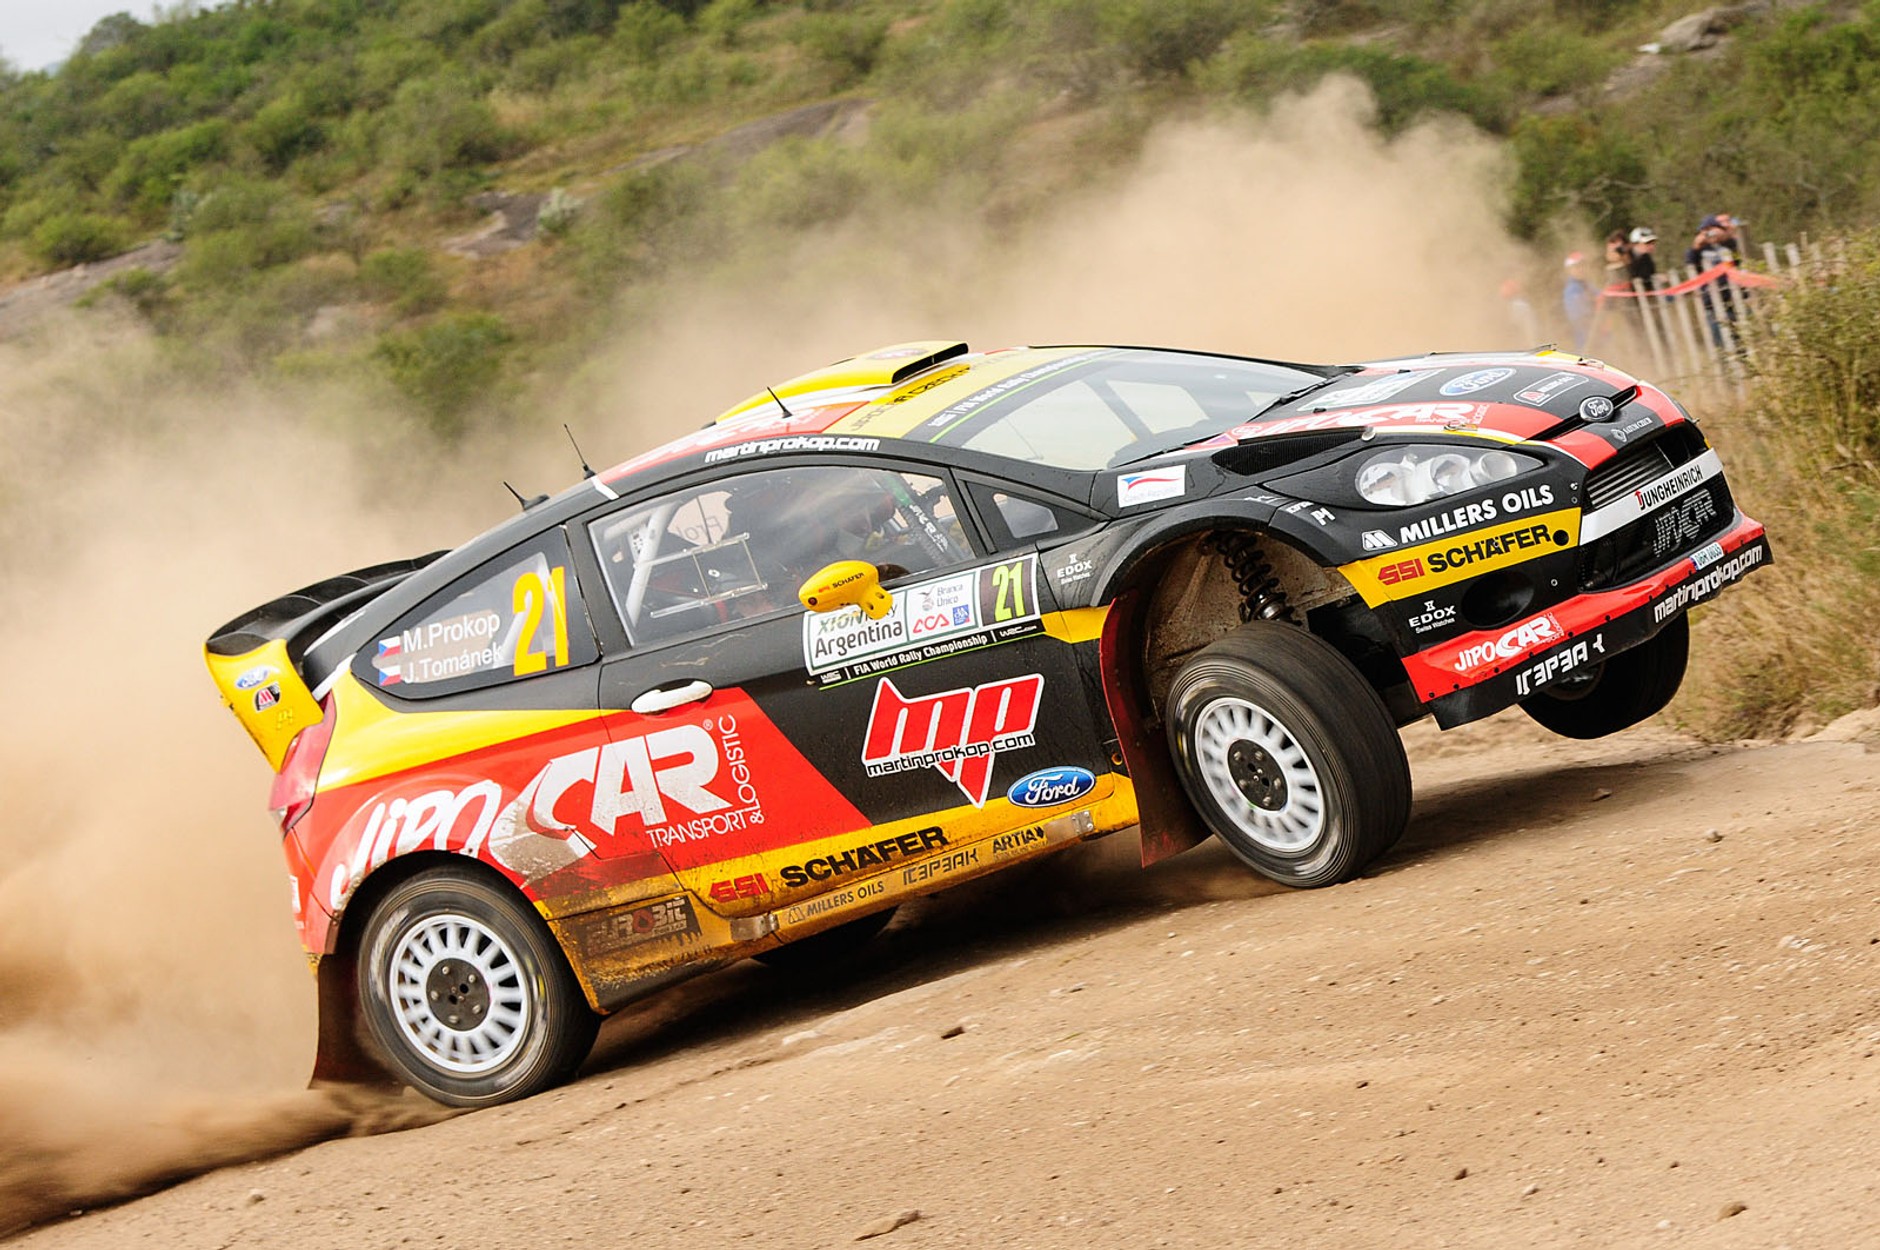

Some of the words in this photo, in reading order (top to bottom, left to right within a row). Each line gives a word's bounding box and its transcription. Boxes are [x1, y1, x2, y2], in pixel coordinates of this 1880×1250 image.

[704, 436, 880, 463] martinprokop.com
[1635, 463, 1704, 511] JUNGHEINRICH
[1399, 499, 1497, 544] MILLERS
[1501, 484, 1555, 514] OILS
[1056, 560, 1093, 579] EDOX
[1377, 557, 1426, 586] SSI
[1426, 523, 1552, 573] SCHÄFER
[992, 560, 1026, 623] 21
[1654, 544, 1763, 624] martinprokop.com
[403, 613, 501, 654] M.Prokop
[512, 565, 570, 677] 21
[1408, 605, 1457, 628] EDOX
[815, 620, 903, 659] Argentina
[853, 665, 871, 676] FIA
[871, 655, 899, 671] World
[899, 650, 923, 665] Rally
[923, 633, 988, 658] Championship
[403, 641, 503, 685] J.Tománek
[718, 714, 761, 812] LOGISTIC
[867, 733, 1035, 776] martinprokop.com
[1024, 772, 1083, 805] Ford
[645, 810, 747, 849] TRANSPORT
[780, 825, 950, 888] SCHÄFER
[903, 847, 979, 886] ICEPEAK
[807, 889, 855, 918] MILLERS
[858, 880, 885, 899] OILS
